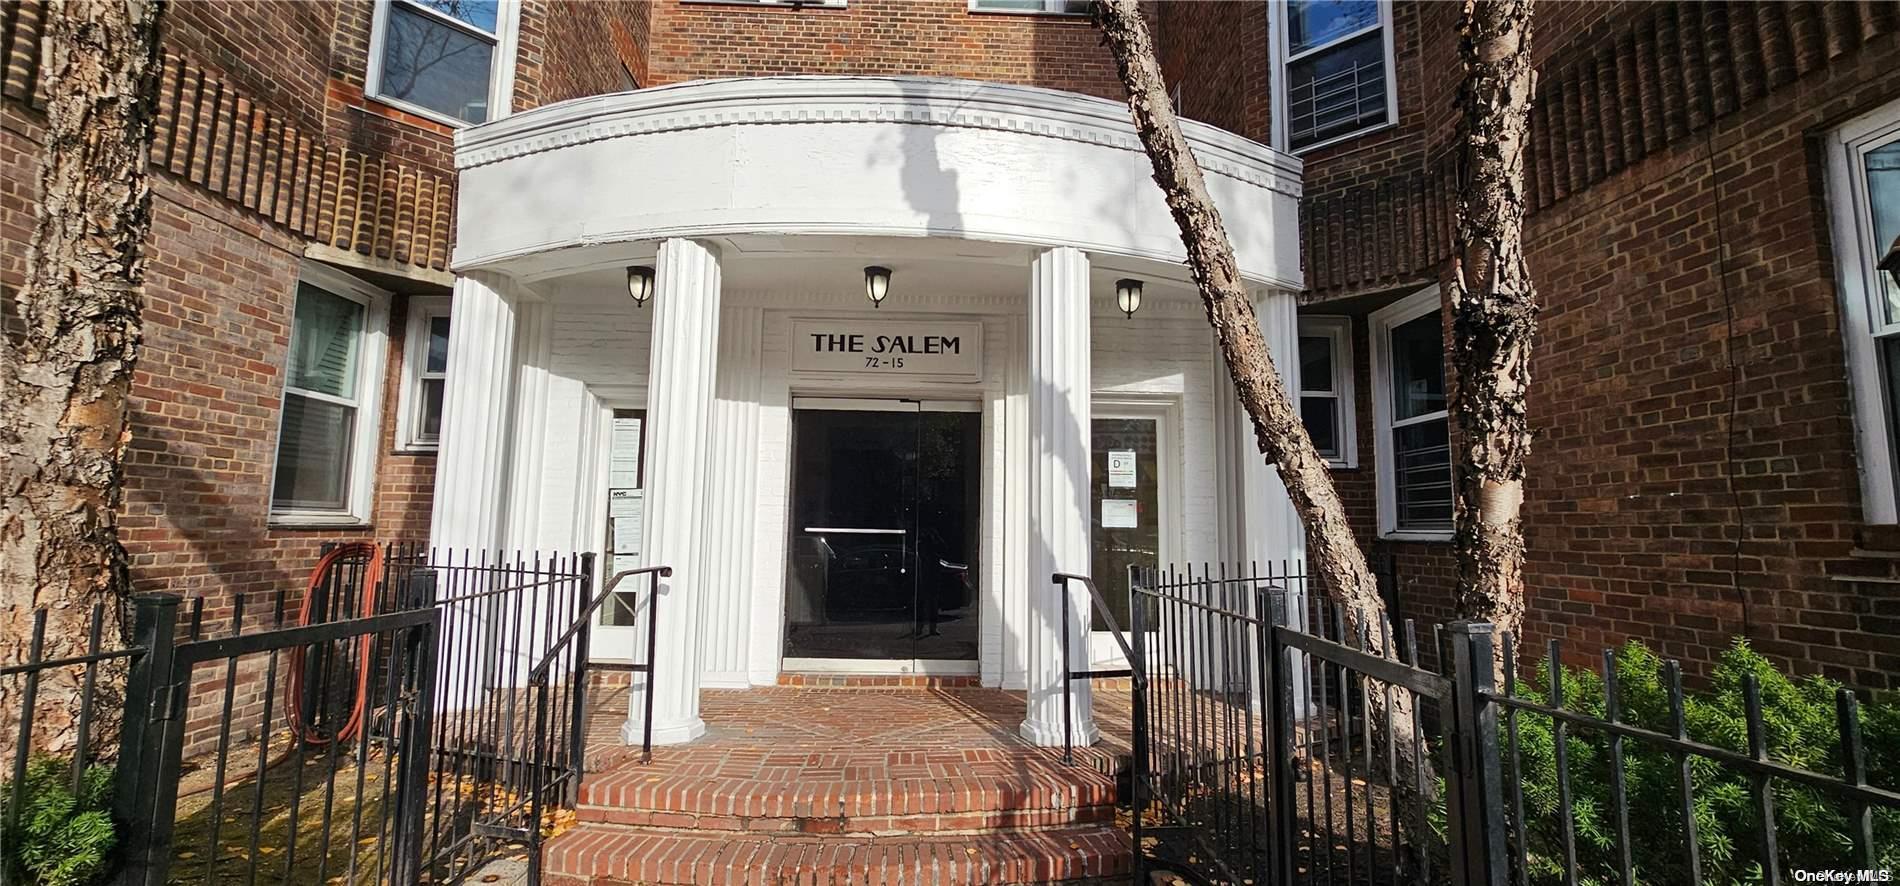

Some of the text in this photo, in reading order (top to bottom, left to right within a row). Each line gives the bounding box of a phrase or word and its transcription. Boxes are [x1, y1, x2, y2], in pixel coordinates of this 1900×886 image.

[811, 334, 960, 354] THE SALEM
[1113, 459, 1121, 468] D
